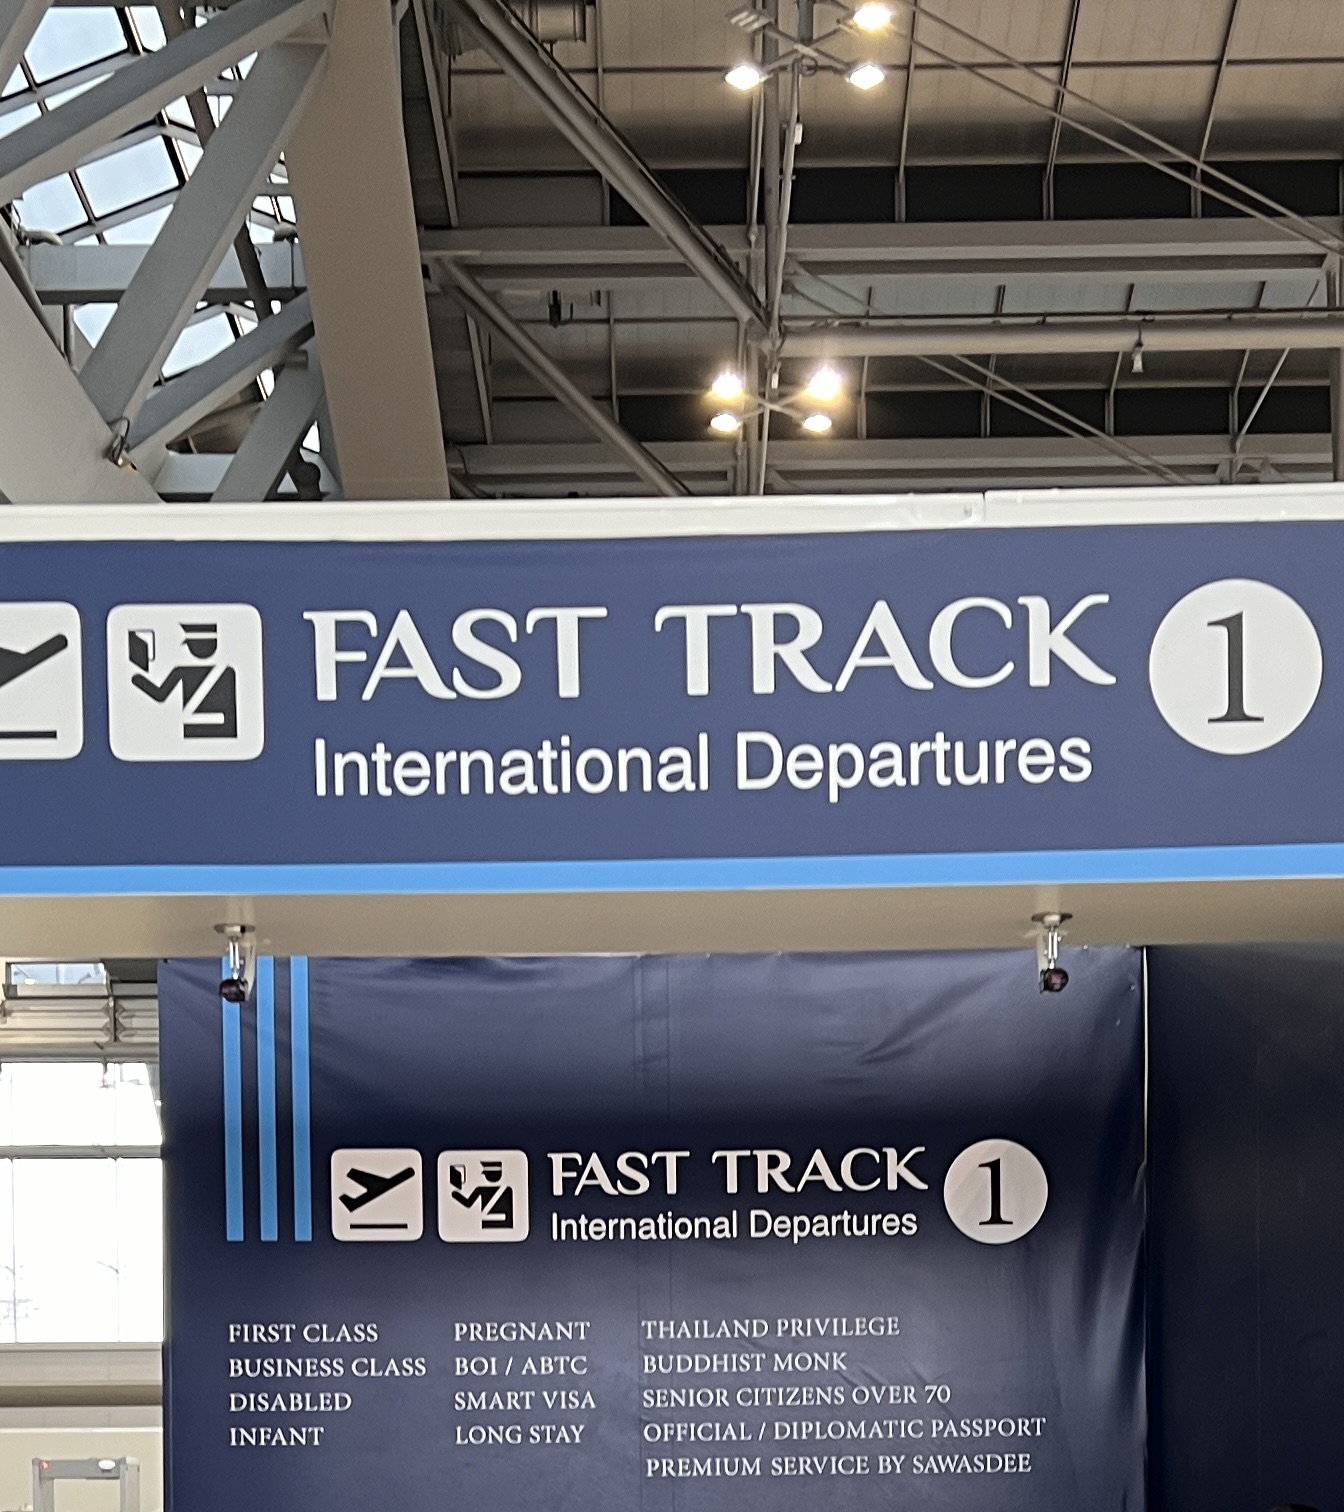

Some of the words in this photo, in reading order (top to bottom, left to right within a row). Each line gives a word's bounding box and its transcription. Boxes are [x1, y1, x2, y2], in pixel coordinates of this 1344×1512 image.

[303, 605, 608, 701] FAST
[654, 594, 1117, 696] TRACK
[1207, 610, 1265, 724] 1
[315, 731, 709, 797] International
[736, 731, 1092, 804] Departures
[547, 1150, 691, 1196] FAST
[711, 1146, 929, 1194] TRACK
[978, 1158, 1014, 1226] 1
[552, 1209, 738, 1241] International
[750, 1209, 918, 1244] Departures
[229, 1323, 296, 1343] FIRST
[302, 1323, 378, 1343] CLASS
[454, 1321, 591, 1342] PREGNANT
[641, 1319, 769, 1340] THAILAND
[777, 1316, 900, 1337] PRIVILEGE
[229, 1357, 345, 1378] BUSINESS
[351, 1357, 427, 1377] CLASS
[455, 1356, 497, 1376] BOI
[505, 1356, 513, 1376] /
[521, 1355, 588, 1376] ABTC
[643, 1352, 766, 1374] BUDDHIST
[773, 1351, 848, 1372] MONK
[229, 1392, 352, 1412] DISABLED
[454, 1390, 536, 1411] SMART
[542, 1390, 596, 1410] VISA
[642, 1388, 730, 1408] SENIOR
[736, 1386, 845, 1407] CITIZENS
[851, 1385, 918, 1405] OVER
[924, 1384, 951, 1404] 70
[230, 1426, 325, 1446] INFANT
[455, 1425, 522, 1445] LONG
[529, 1424, 585, 1444] STAY
[643, 1421, 752, 1442] OFFICIAL
[758, 1421, 767, 1441] /
[774, 1419, 924, 1440] DIPLOMATIC
[931, 1417, 1047, 1438] PASSPORT
[646, 1457, 761, 1478] PREMIUM
[771, 1455, 870, 1476] SERVICE
[878, 1454, 906, 1474] BY
[912, 1453, 1032, 1474] SAWASDEE
